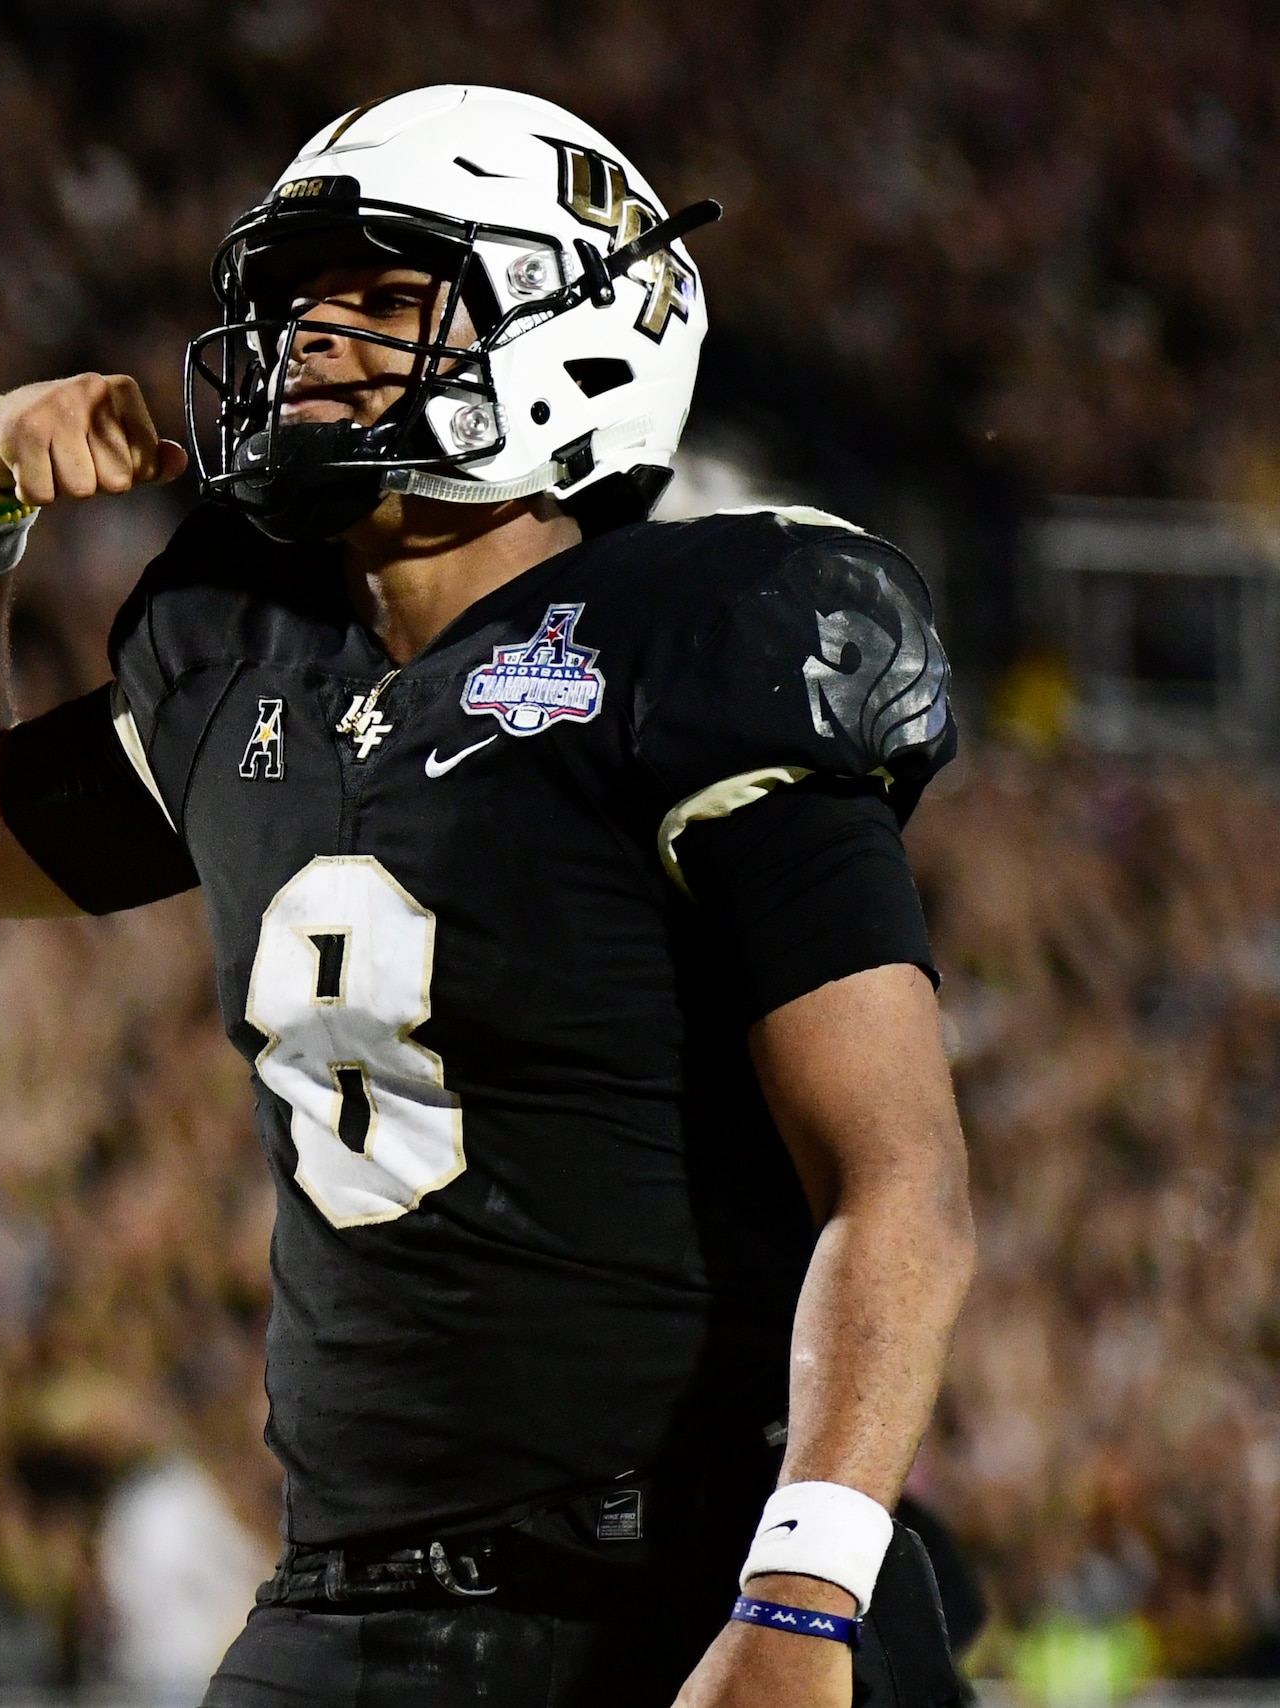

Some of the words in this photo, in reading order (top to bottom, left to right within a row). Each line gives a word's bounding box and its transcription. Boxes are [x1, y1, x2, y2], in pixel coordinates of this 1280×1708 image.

[496, 665, 582, 679] FOOTBALL
[469, 674, 598, 710] CHAMPIONSHIP
[245, 854, 467, 1229] 8
